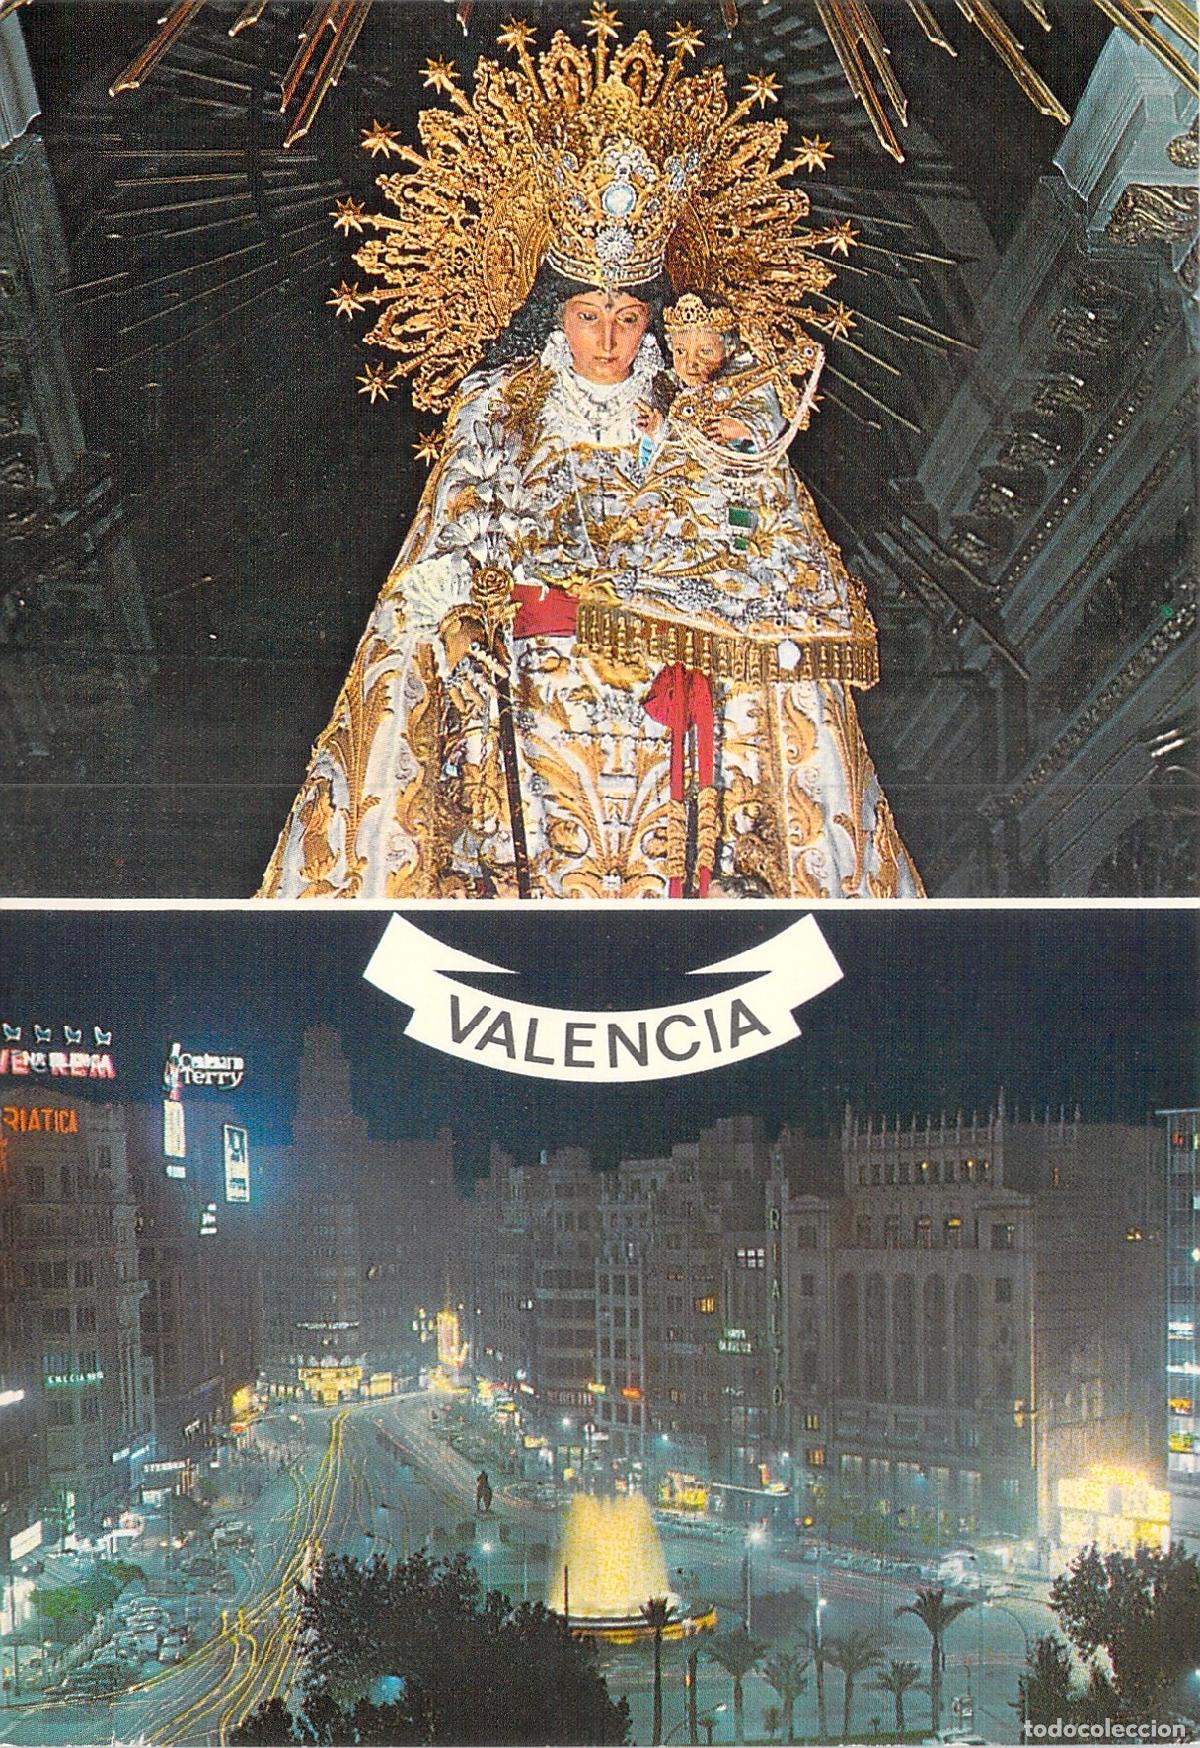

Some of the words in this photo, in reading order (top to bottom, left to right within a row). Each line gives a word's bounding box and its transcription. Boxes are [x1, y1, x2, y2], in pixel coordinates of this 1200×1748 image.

[451, 994, 771, 1068] VALENCIA
[180, 1066, 244, 1090] Terry
[769, 1208, 783, 1406] RIALTO
